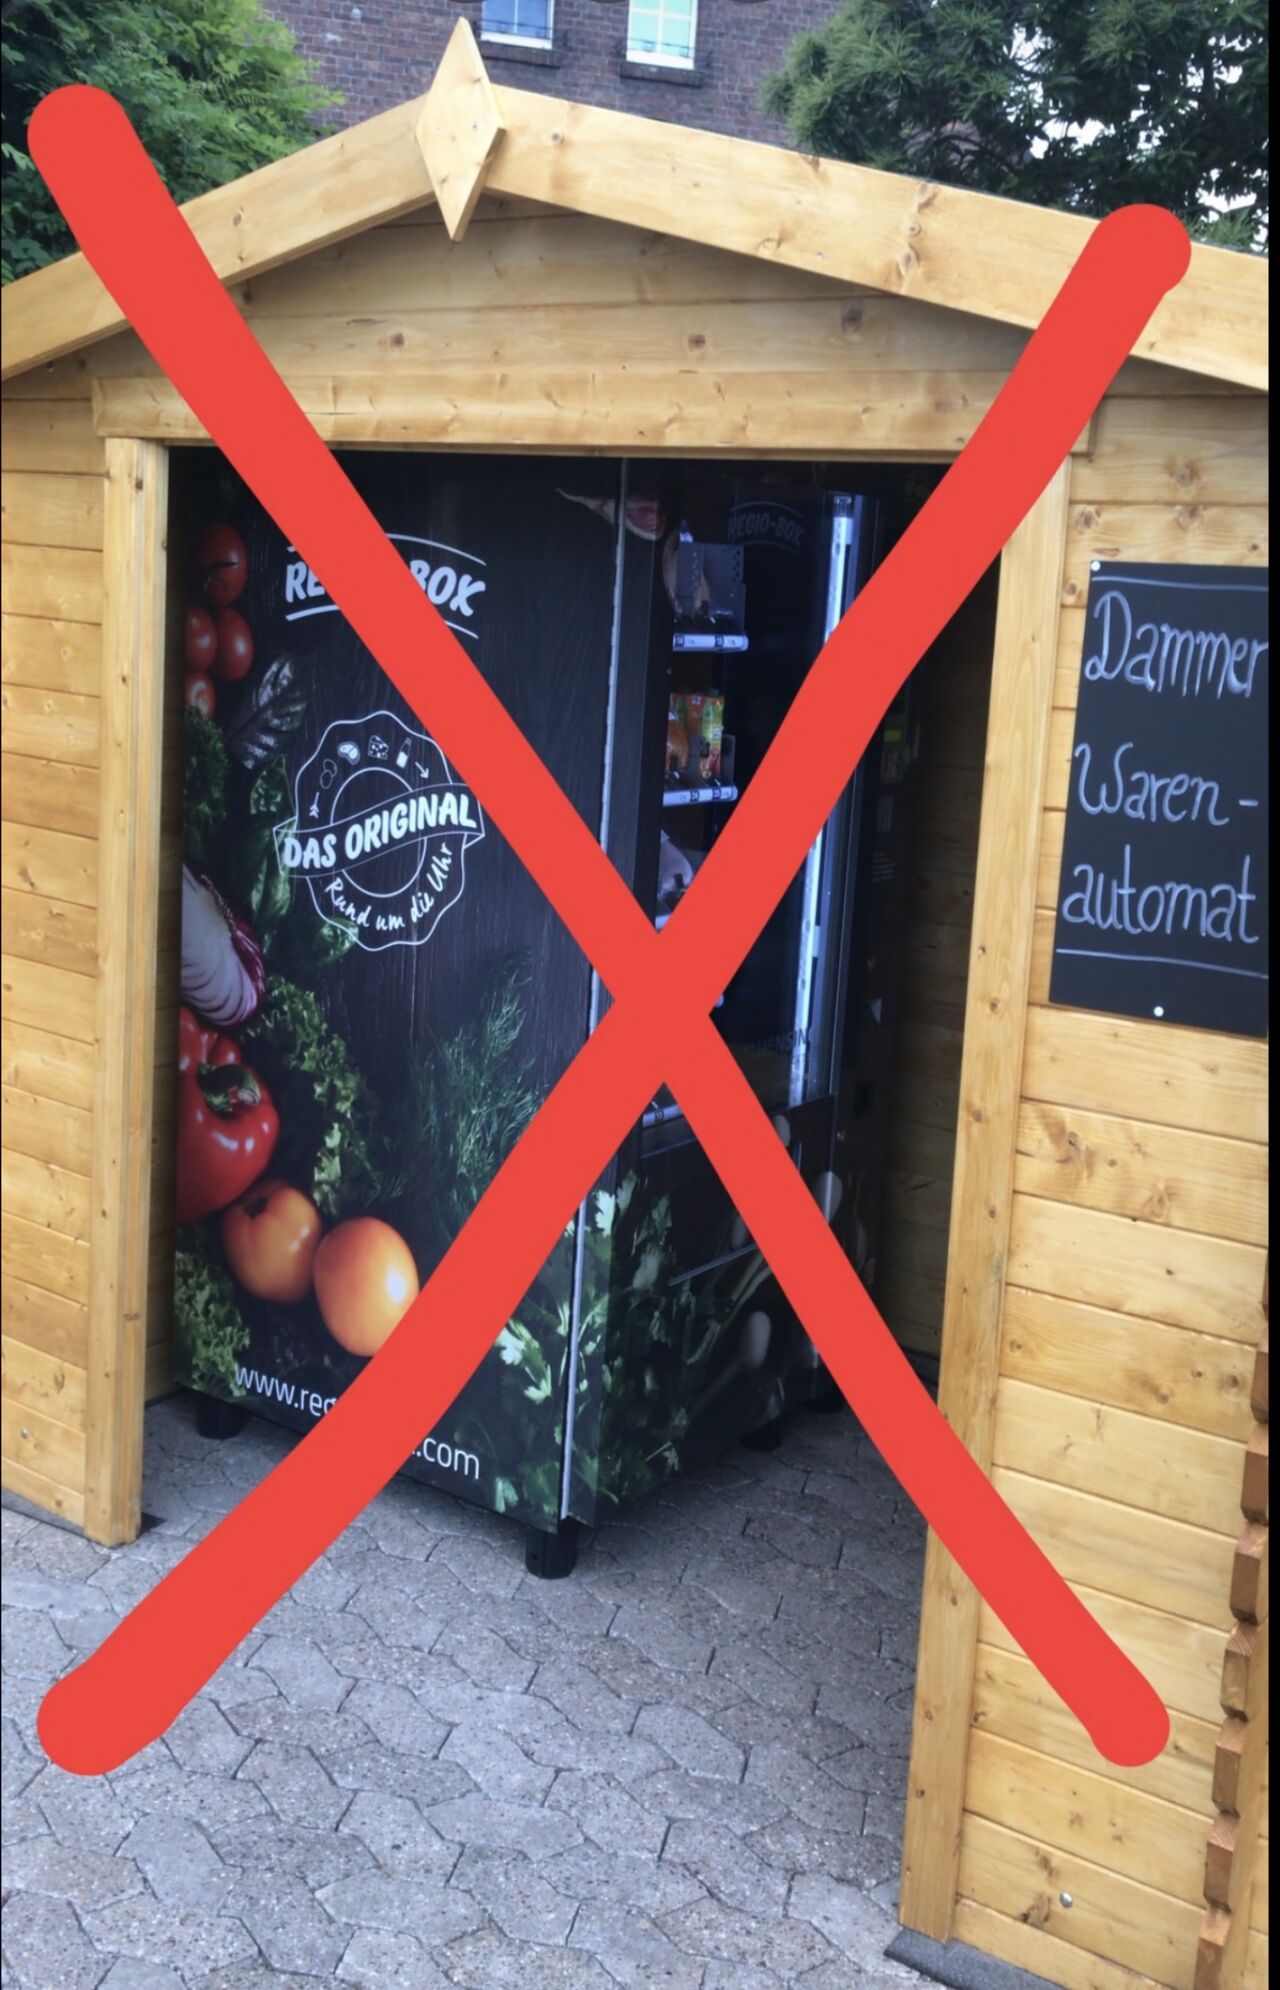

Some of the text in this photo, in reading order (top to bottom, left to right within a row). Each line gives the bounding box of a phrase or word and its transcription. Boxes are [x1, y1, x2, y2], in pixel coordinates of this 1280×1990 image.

[1084, 590, 1268, 699] Dammer
[284, 792, 477, 869] DAS ORIGINAL
[324, 842, 453, 931] Rund um die Uhr
[1062, 844, 1259, 943] automat
